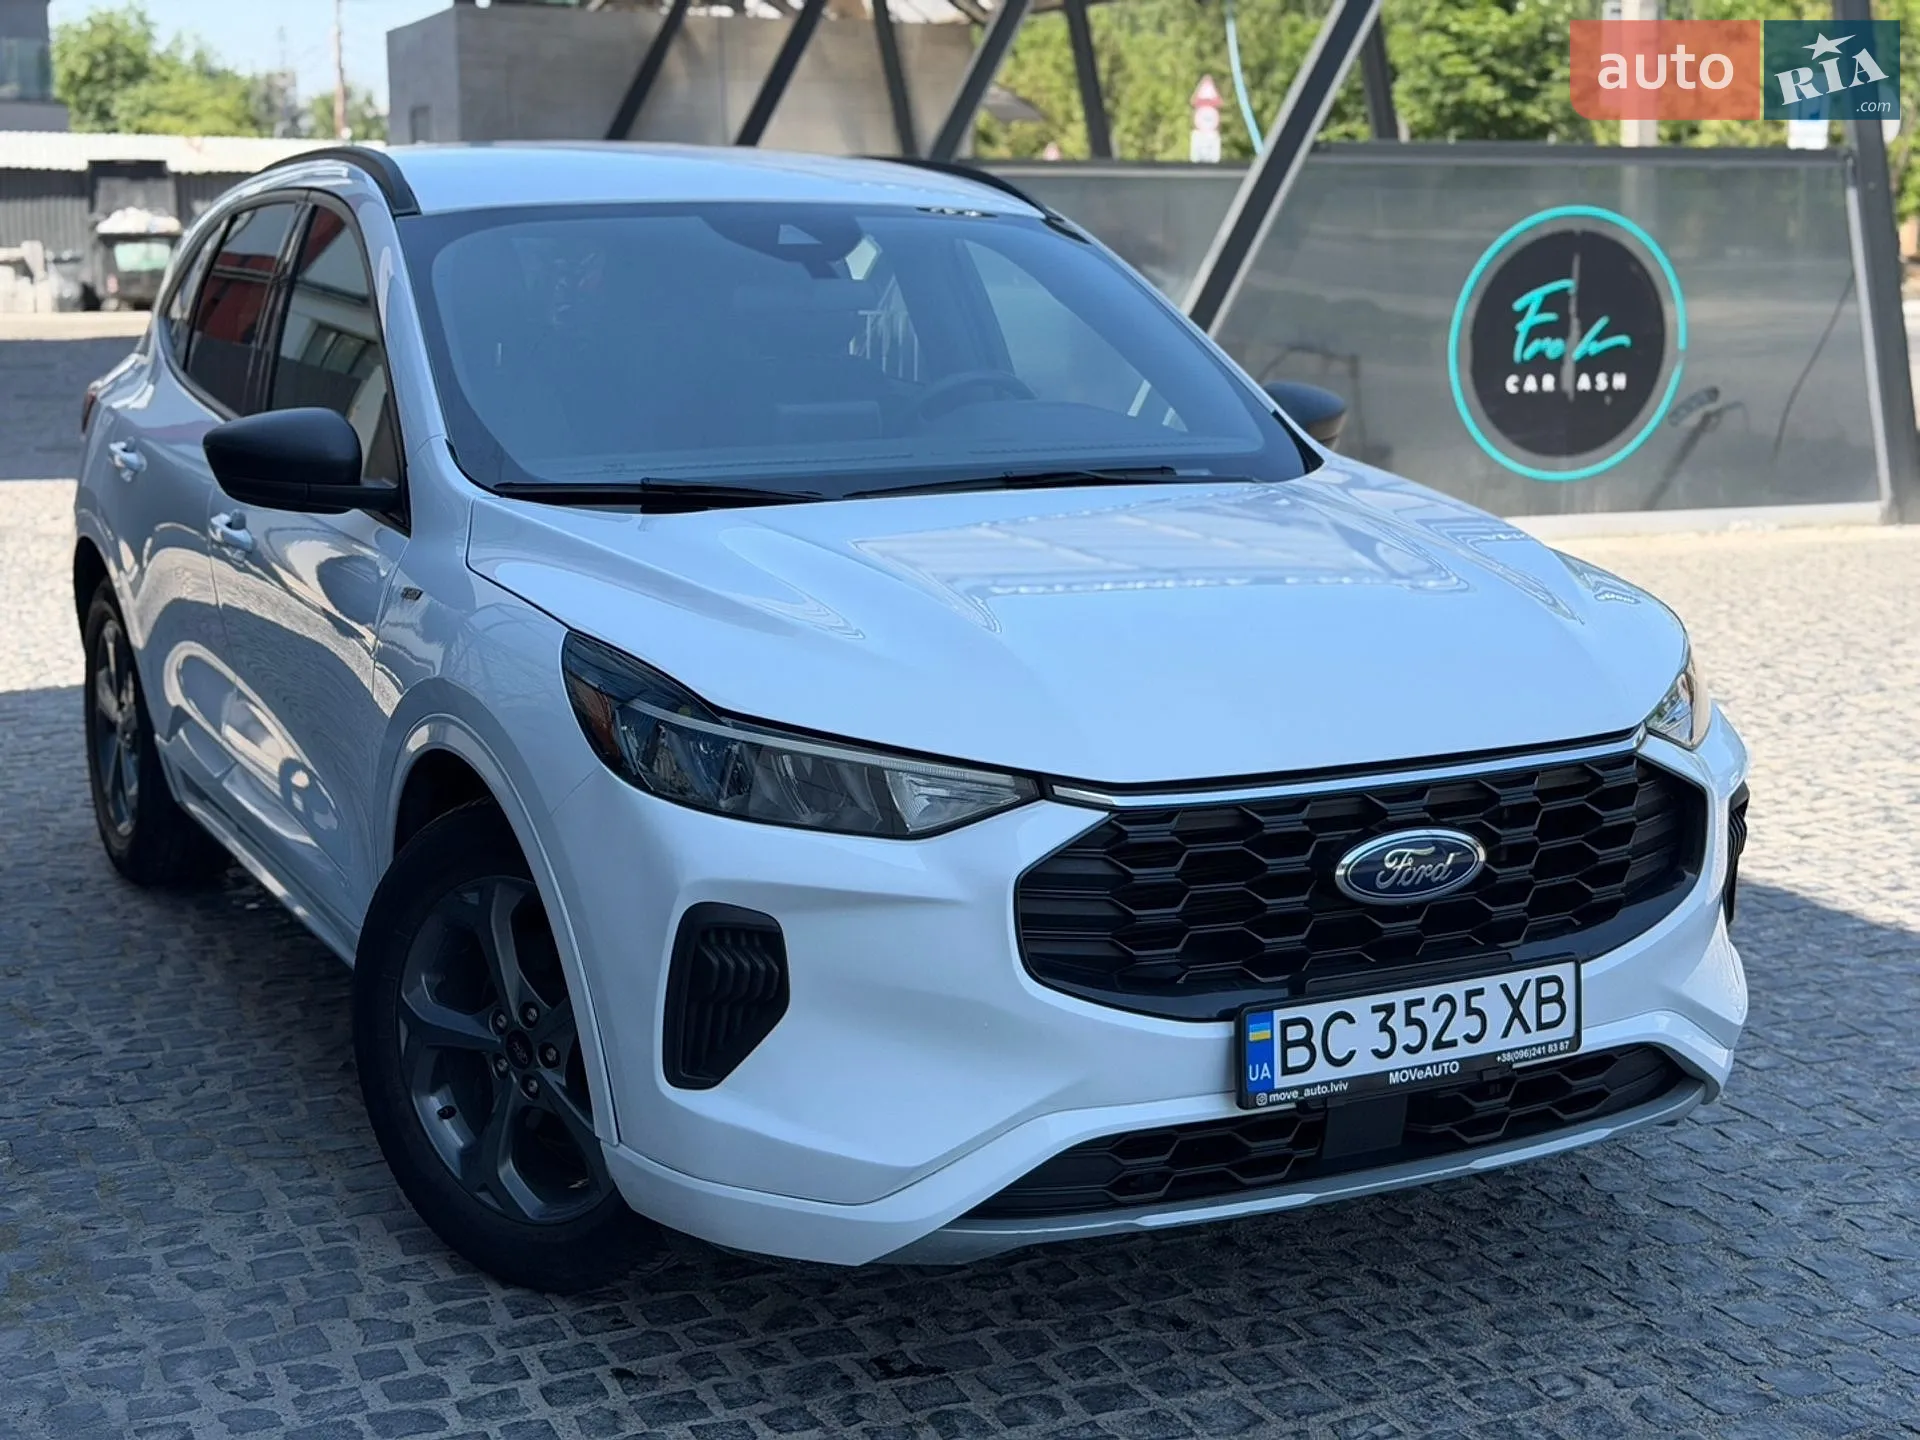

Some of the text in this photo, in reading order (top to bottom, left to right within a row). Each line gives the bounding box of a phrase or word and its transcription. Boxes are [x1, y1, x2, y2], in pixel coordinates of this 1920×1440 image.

[1505, 371, 1628, 395] CAR ASH
[1375, 845, 1463, 890] Ford
[1279, 974, 1567, 1077] BC 3525 XB
[1249, 1063, 1272, 1082] UA
[1389, 1060, 1460, 1085] MOVeAUTO
[1269, 1081, 1349, 1103] move_auto.lviv
